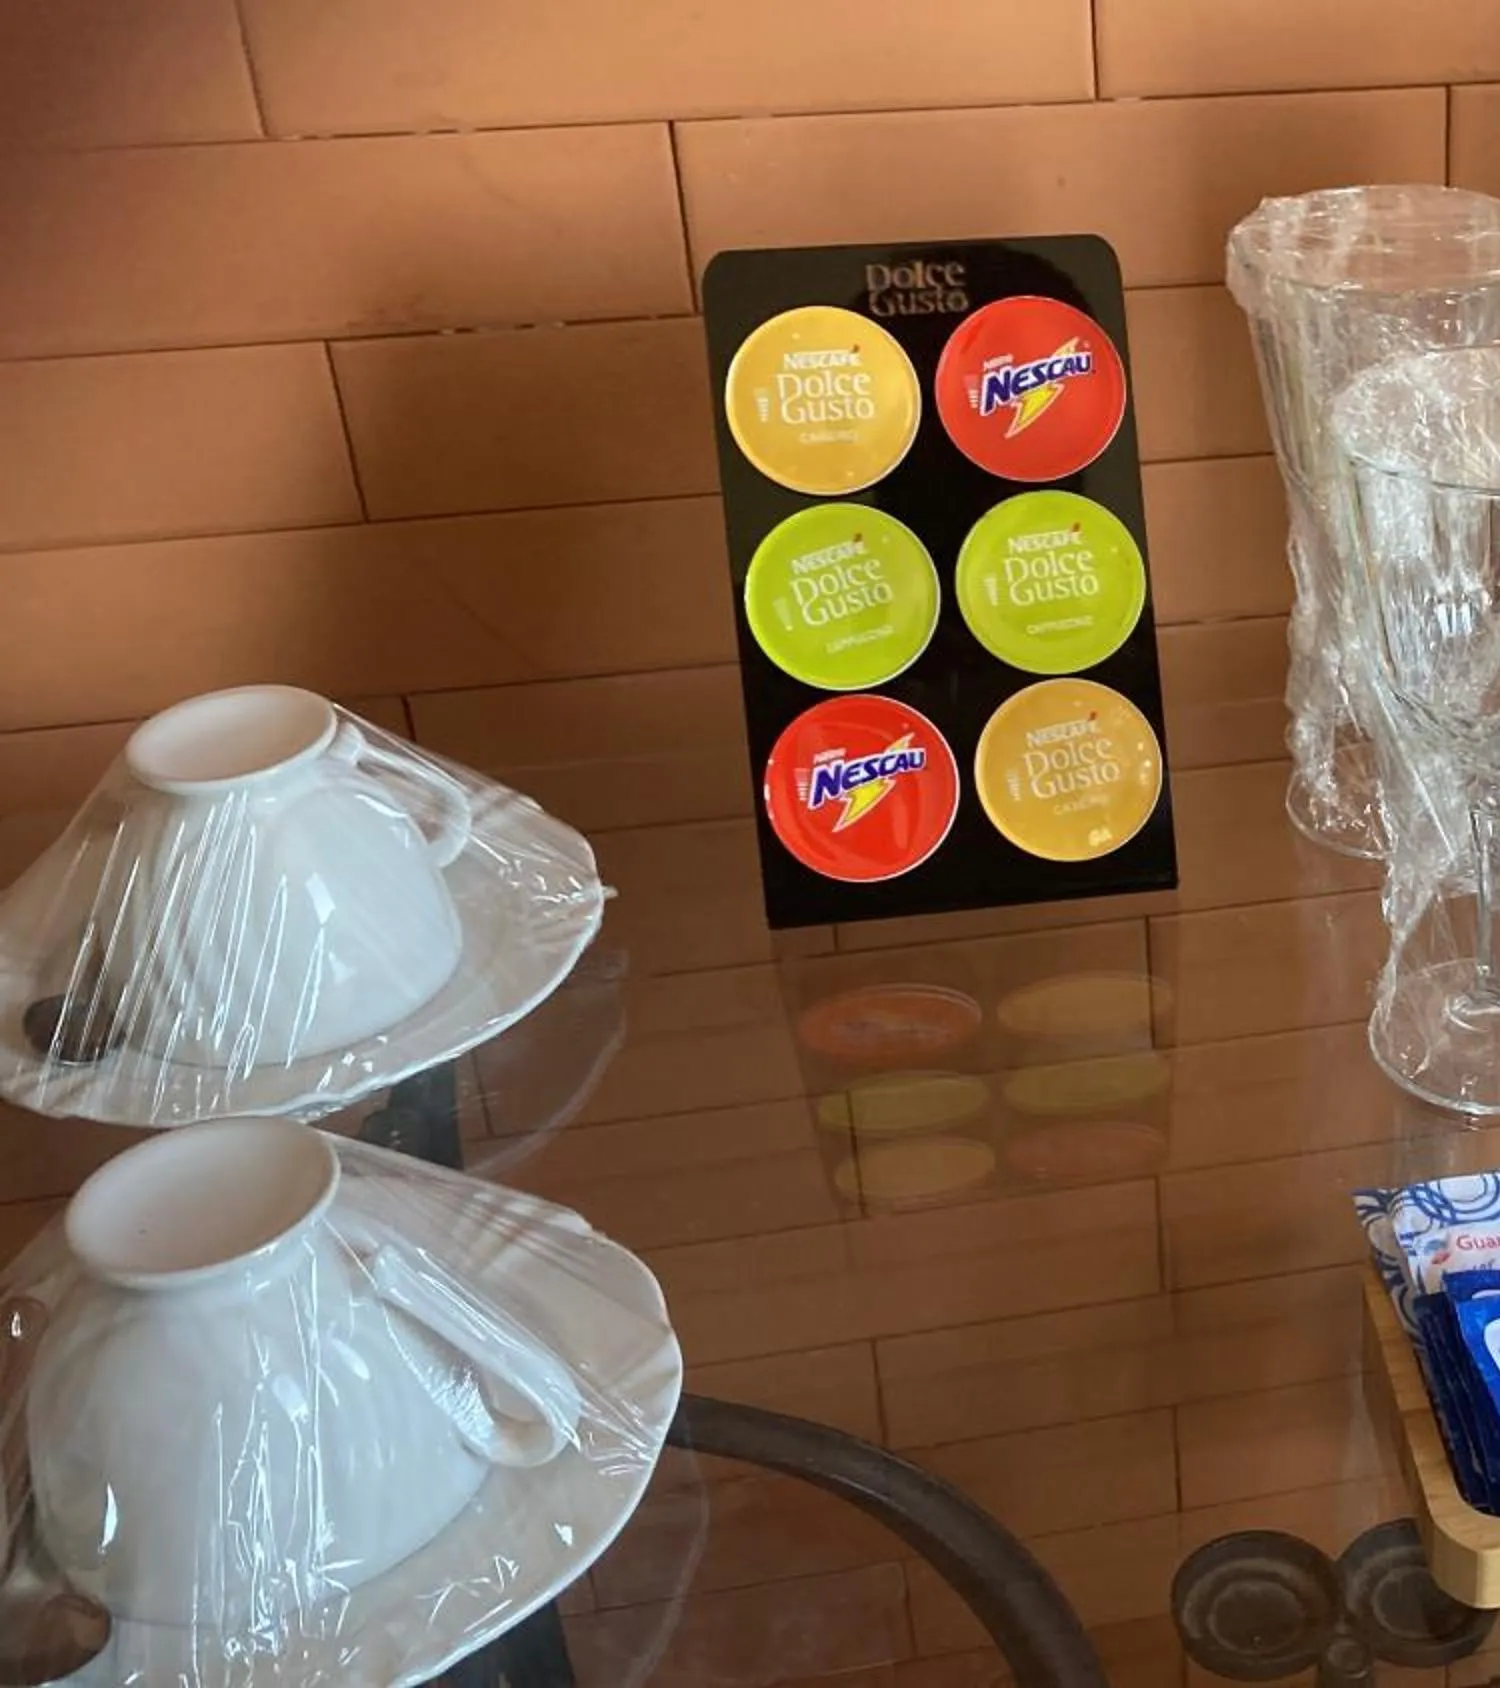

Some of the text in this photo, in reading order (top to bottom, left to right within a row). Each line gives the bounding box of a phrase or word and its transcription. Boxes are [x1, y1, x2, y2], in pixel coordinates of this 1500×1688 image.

[866, 261, 967, 291] Dolce
[869, 287, 969, 317] Gusto
[776, 370, 872, 400] Dolce
[981, 353, 1092, 415] NESCAU
[781, 396, 875, 425] Gusto
[789, 559, 885, 605] Dolce
[1004, 550, 1094, 583] Dolce
[801, 582, 894, 626] Gusto
[1010, 574, 1099, 606] Gusto
[1024, 738, 1117, 778] Dolce
[809, 748, 925, 810] NESCAU
[1031, 761, 1121, 799] Gusto
